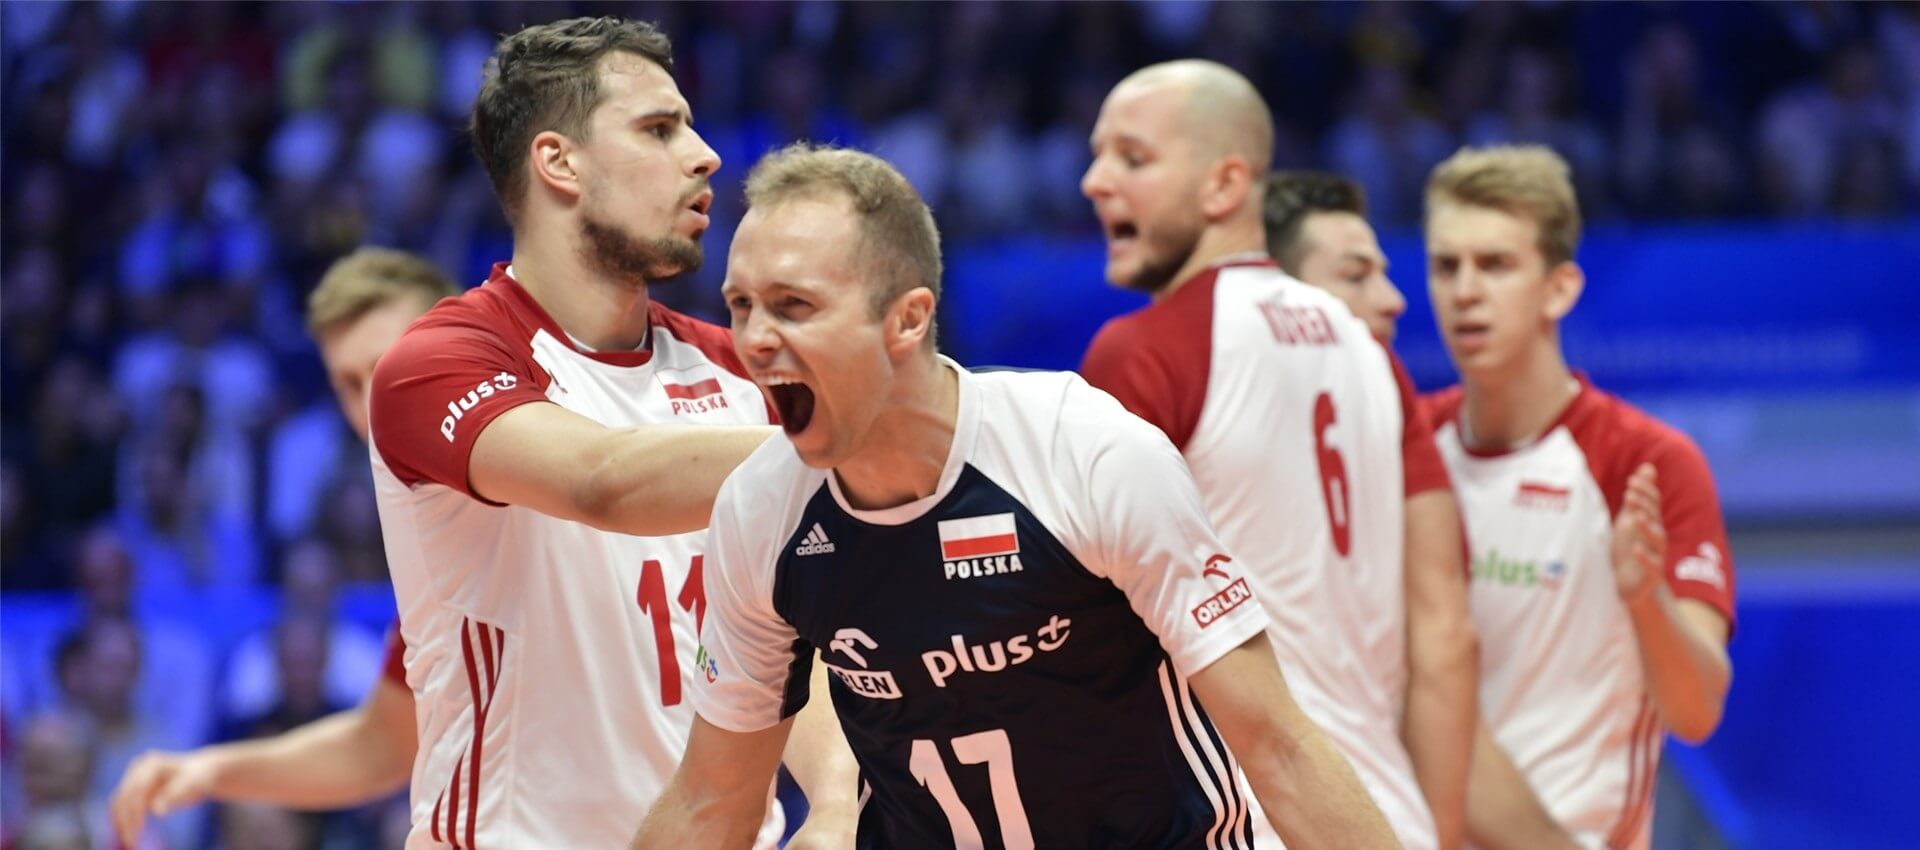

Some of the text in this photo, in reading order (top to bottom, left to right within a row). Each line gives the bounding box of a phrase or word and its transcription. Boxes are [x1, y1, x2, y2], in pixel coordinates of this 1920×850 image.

[671, 395, 729, 416] POLSKA
[1313, 391, 1351, 557] 6
[796, 542, 836, 557] adidas
[944, 554, 1024, 580] POLSKA
[1196, 580, 1250, 625] ORLEN
[909, 728, 1036, 850] 17
